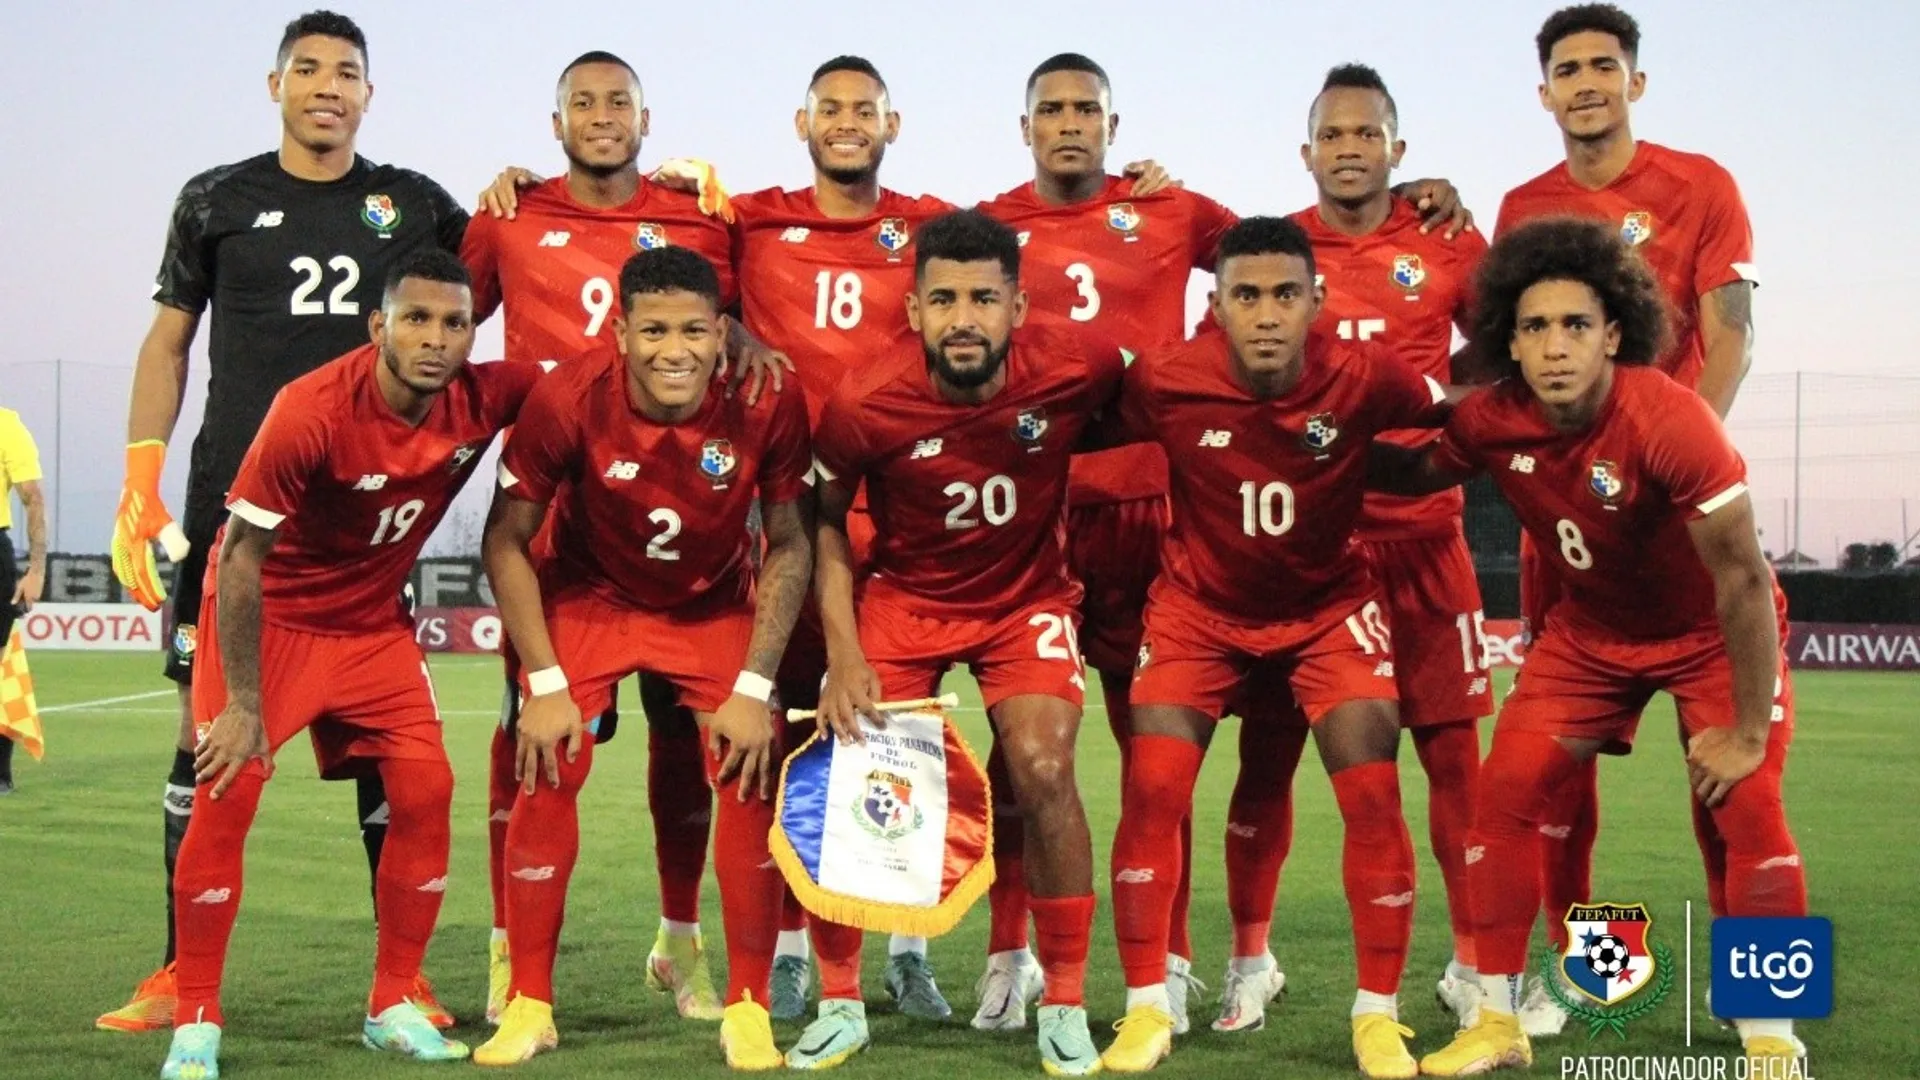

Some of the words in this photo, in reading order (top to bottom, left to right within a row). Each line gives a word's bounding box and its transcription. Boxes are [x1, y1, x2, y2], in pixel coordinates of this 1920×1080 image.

[290, 256, 360, 315] 22
[581, 277, 613, 336] 9
[814, 271, 862, 329] 18
[1065, 263, 1100, 321] 3
[370, 499, 424, 545] 19
[943, 474, 1017, 529] 20
[1240, 481, 1294, 535] 10
[647, 507, 681, 560] 2
[1557, 519, 1592, 569] 8
[27, 614, 151, 641] OYOTA
[1345, 600, 1392, 655] 10
[1801, 633, 1920, 662] AIRWA
[1769, 704, 1784, 722] B
